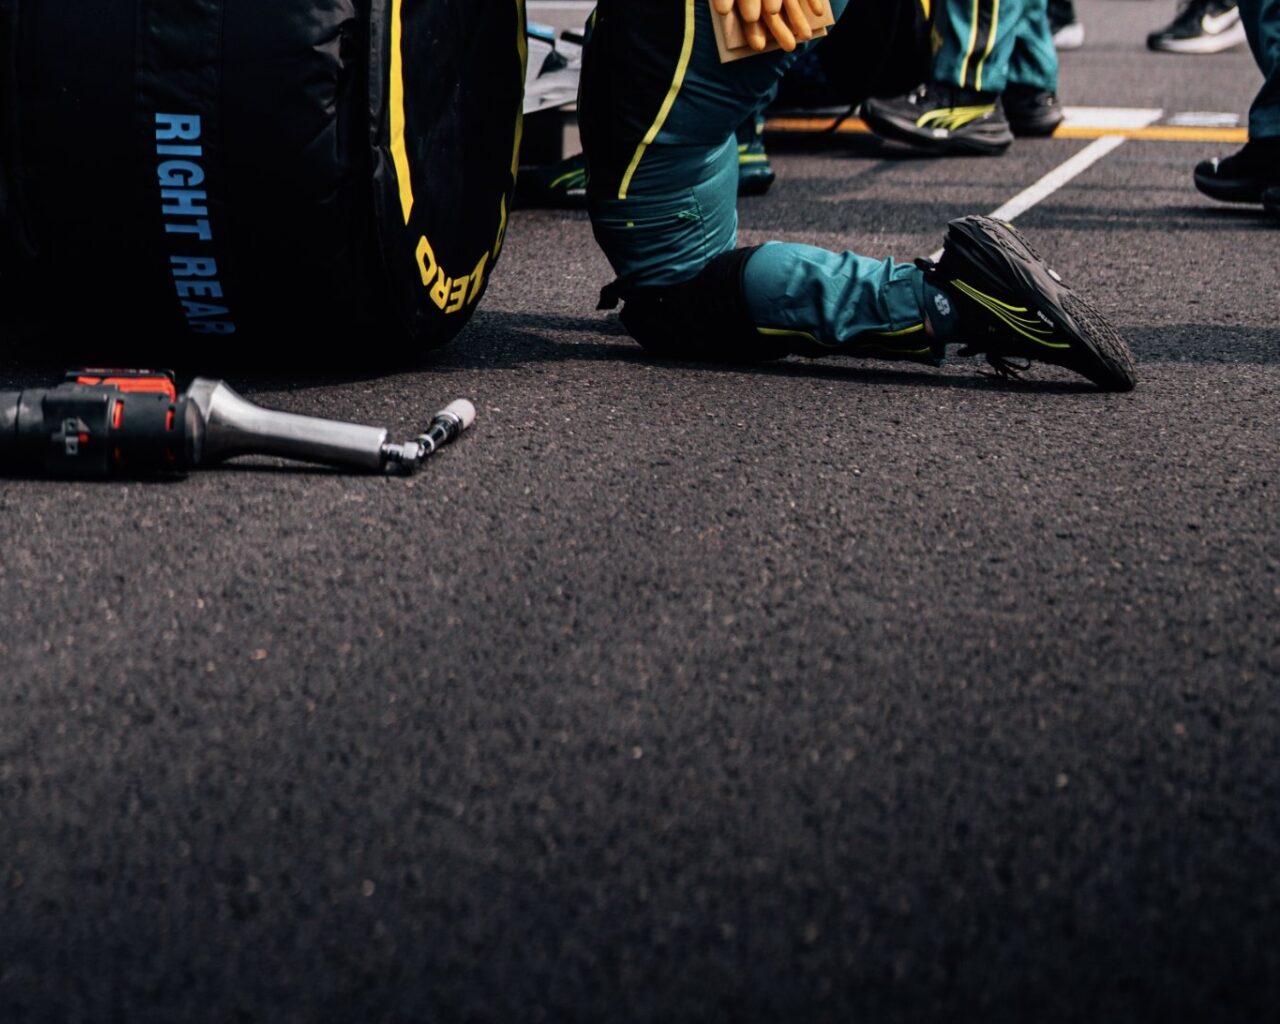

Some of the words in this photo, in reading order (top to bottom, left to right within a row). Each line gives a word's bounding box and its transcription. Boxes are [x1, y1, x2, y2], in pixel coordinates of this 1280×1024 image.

[155, 113, 213, 241] RIGHT
[169, 254, 236, 335] REAR
[415, 234, 490, 315] ZERO
